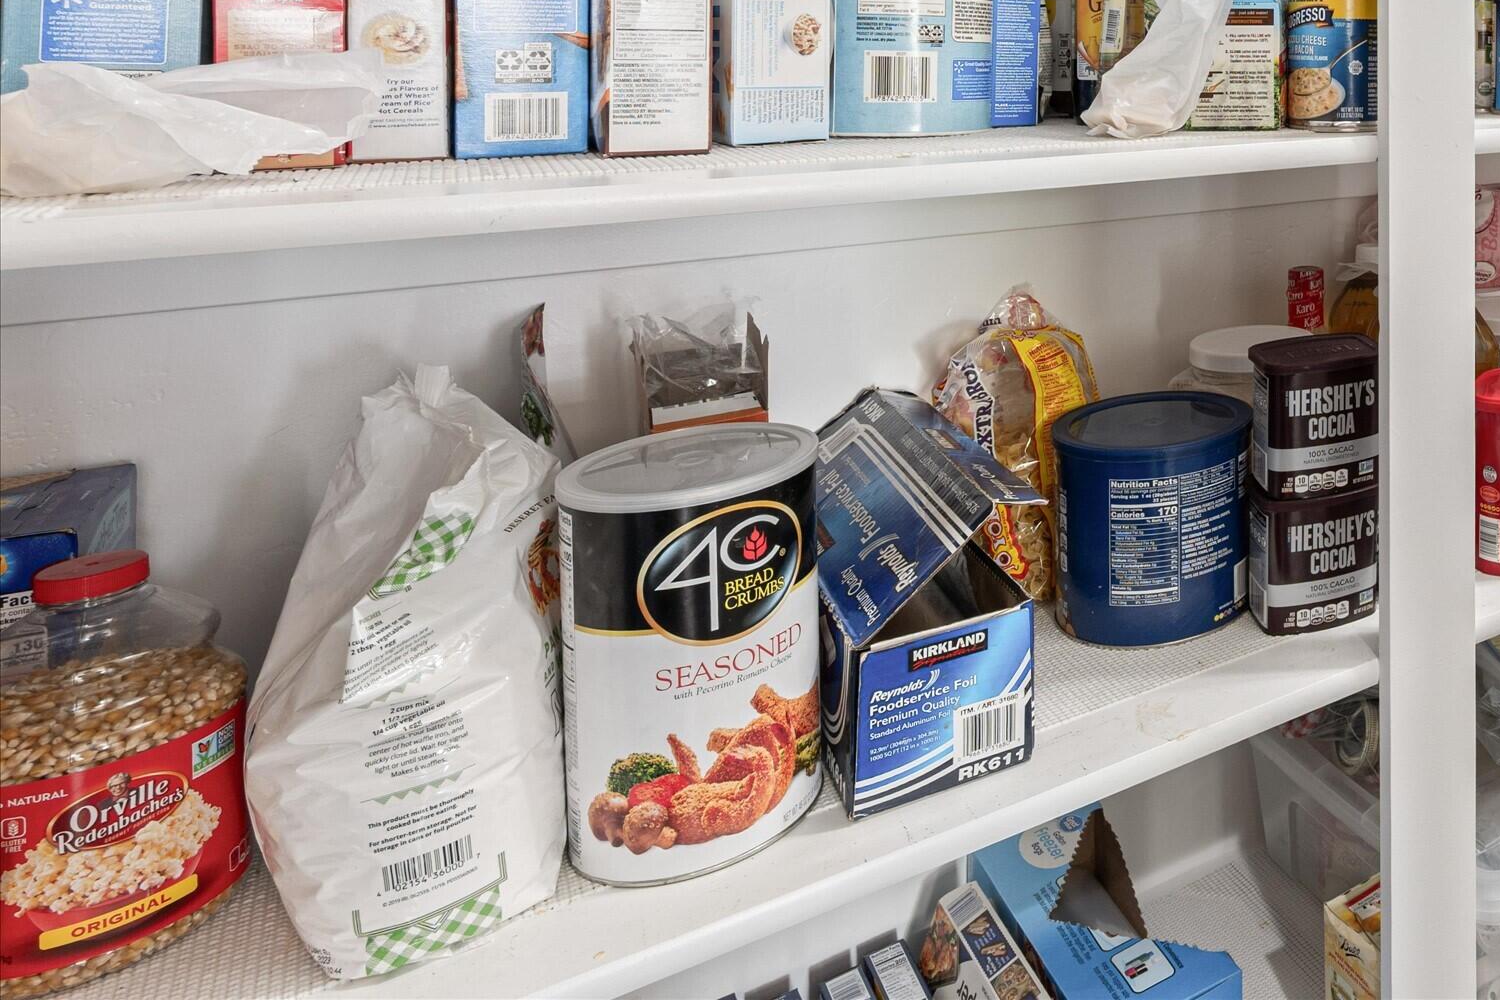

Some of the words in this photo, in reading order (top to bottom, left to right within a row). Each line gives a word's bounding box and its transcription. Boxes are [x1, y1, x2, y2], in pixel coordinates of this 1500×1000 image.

[1302, 37, 1326, 45] CHEESE
[1295, 301, 1316, 315] Karo
[1289, 378, 1375, 418] HERSHEY'S
[1308, 413, 1356, 440] COCOA
[1309, 449, 1327, 459] 100%
[1328, 445, 1355, 455] CACAO
[832, 484, 882, 543] Foodservice
[1158, 506, 1177, 515] 170
[1290, 509, 1375, 553] HERSHEY'S
[655, 513, 780, 633] 4C
[876, 542, 919, 592] Reynolds
[1310, 546, 1356, 575] COCOA
[724, 566, 775, 596] BREAD
[724, 576, 786, 612] CRUMBS
[837, 565, 865, 596] Quality
[1310, 583, 1329, 592] 100%
[1329, 576, 1356, 589] CACAO
[853, 589, 882, 626] Premium
[655, 622, 803, 694] SEASONED
[913, 632, 985, 661] KIRKLAND
[673, 689, 694, 701] with
[696, 676, 735, 696] Pecorino
[736, 666, 768, 686] Romano
[769, 651, 793, 675] Cheese
[870, 679, 926, 704] Reynolds
[870, 685, 950, 717] Foodservice
[954, 675, 977, 690] Foil
[870, 709, 918, 729] Premium
[922, 696, 960, 713] Quality
[870, 726, 900, 740] Standard
[902, 715, 936, 730] Aluminum
[958, 748, 1025, 781] RK611
[7, 789, 68, 807] NATURAL
[70, 779, 169, 829] Orville
[383, 813, 409, 826] product
[439, 789, 474, 809] thoroughly
[53, 789, 184, 854] Redenbacher's
[381, 827, 426, 844] shorter-term
[1, 838, 26, 848] GLUTEN
[71, 893, 173, 938] ORIGINAL
